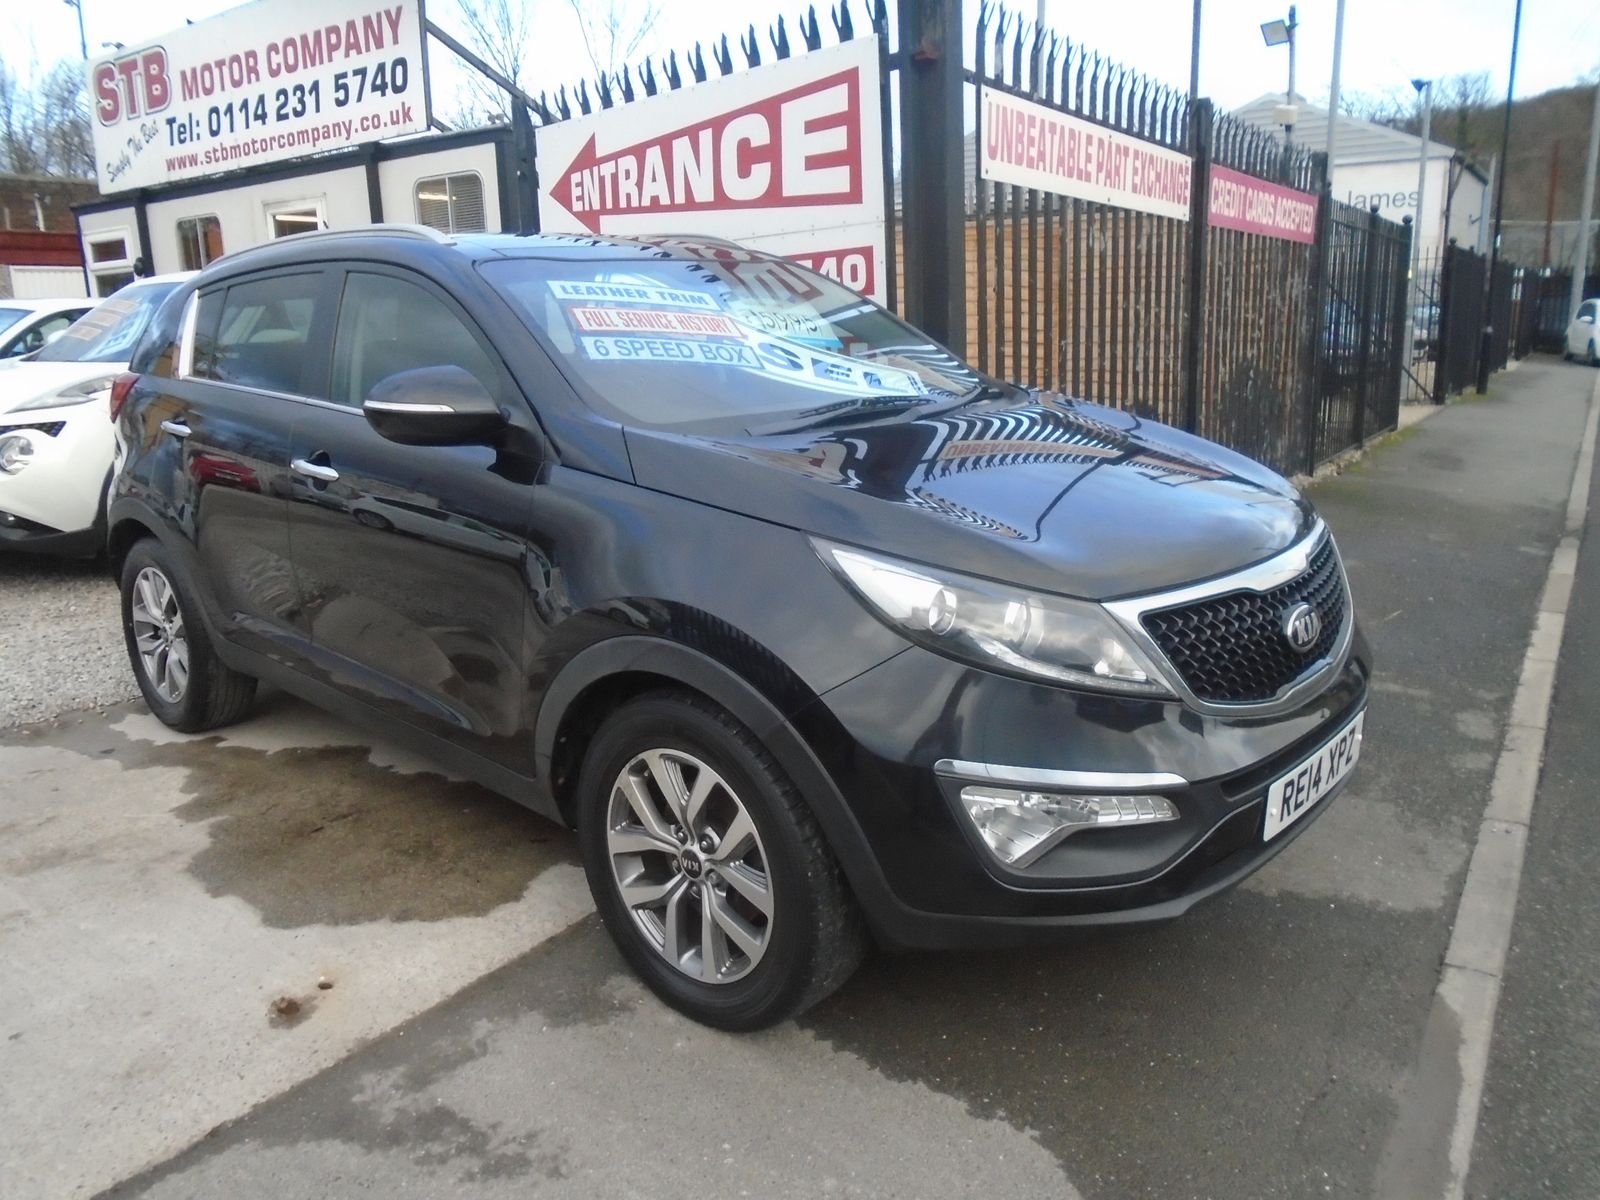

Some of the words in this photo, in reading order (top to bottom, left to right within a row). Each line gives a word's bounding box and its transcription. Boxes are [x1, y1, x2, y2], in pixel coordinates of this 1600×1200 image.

[95, 46, 170, 125] STB
[180, 50, 260, 101] MOTOR
[266, 6, 403, 79] COMPANY
[165, 102, 414, 172] www.stbmotorcompany.co.uk
[166, 115, 201, 146] Tel:
[207, 95, 268, 138] 0114
[275, 80, 321, 122] 231
[334, 56, 408, 108] 5740
[570, 82, 851, 212] ENTRANCE
[987, 101, 1093, 183] UNBEATABLE
[1096, 137, 1129, 191] PART
[1132, 149, 1190, 206] EXCHANGE
[1211, 177, 1245, 219] CREDIT
[1246, 187, 1275, 226] CARDS
[1275, 196, 1314, 234] ACCEPTED
[560, 284, 651, 299] LEATHER
[655, 291, 712, 305] TRIM
[583, 310, 617, 328] FULL
[617, 312, 676, 330] SERVICE
[673, 315, 733, 334] HISTORY
[594, 339, 609, 357] 6
[614, 340, 695, 359] SPEED
[702, 344, 753, 364] BOX
[1294, 611, 1319, 645] KIA
[1279, 755, 1323, 823] RE14
[1325, 727, 1357, 786] XPZ
